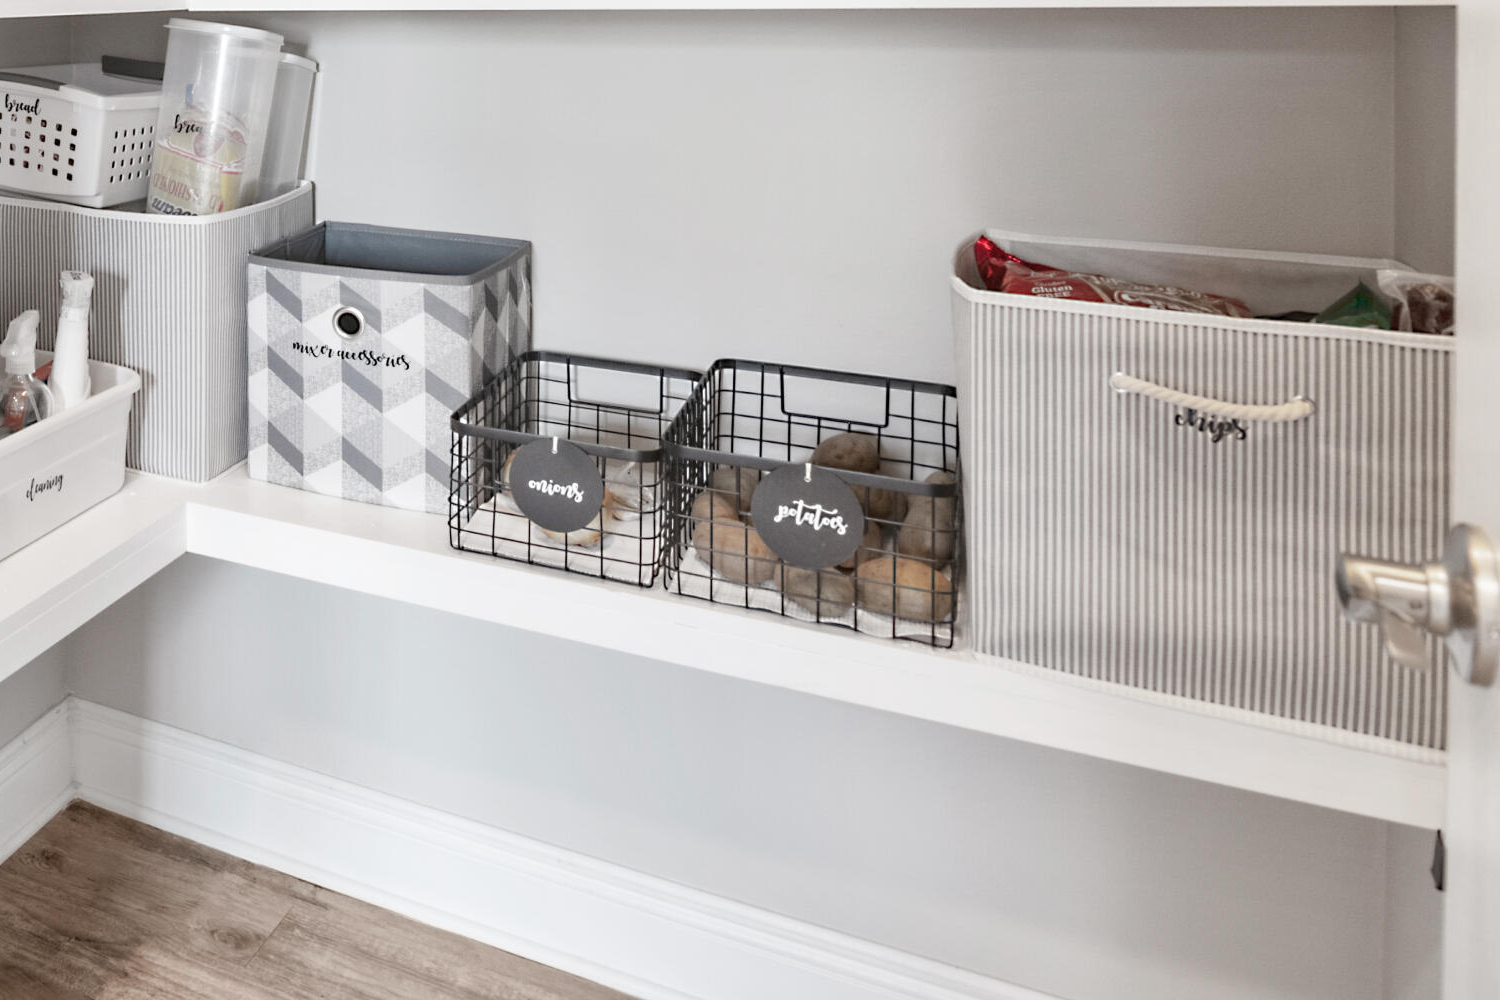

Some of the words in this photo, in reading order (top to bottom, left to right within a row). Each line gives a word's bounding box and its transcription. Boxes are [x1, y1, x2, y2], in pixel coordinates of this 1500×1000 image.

[5, 94, 41, 116] bread
[1031, 285, 1073, 294] Gluten
[292, 341, 333, 359] mixer
[337, 349, 411, 371] accessories
[1174, 407, 1249, 443] chips
[26, 473, 64, 503] cleaning
[528, 479, 585, 503] onions
[773, 499, 849, 536] potatoes
